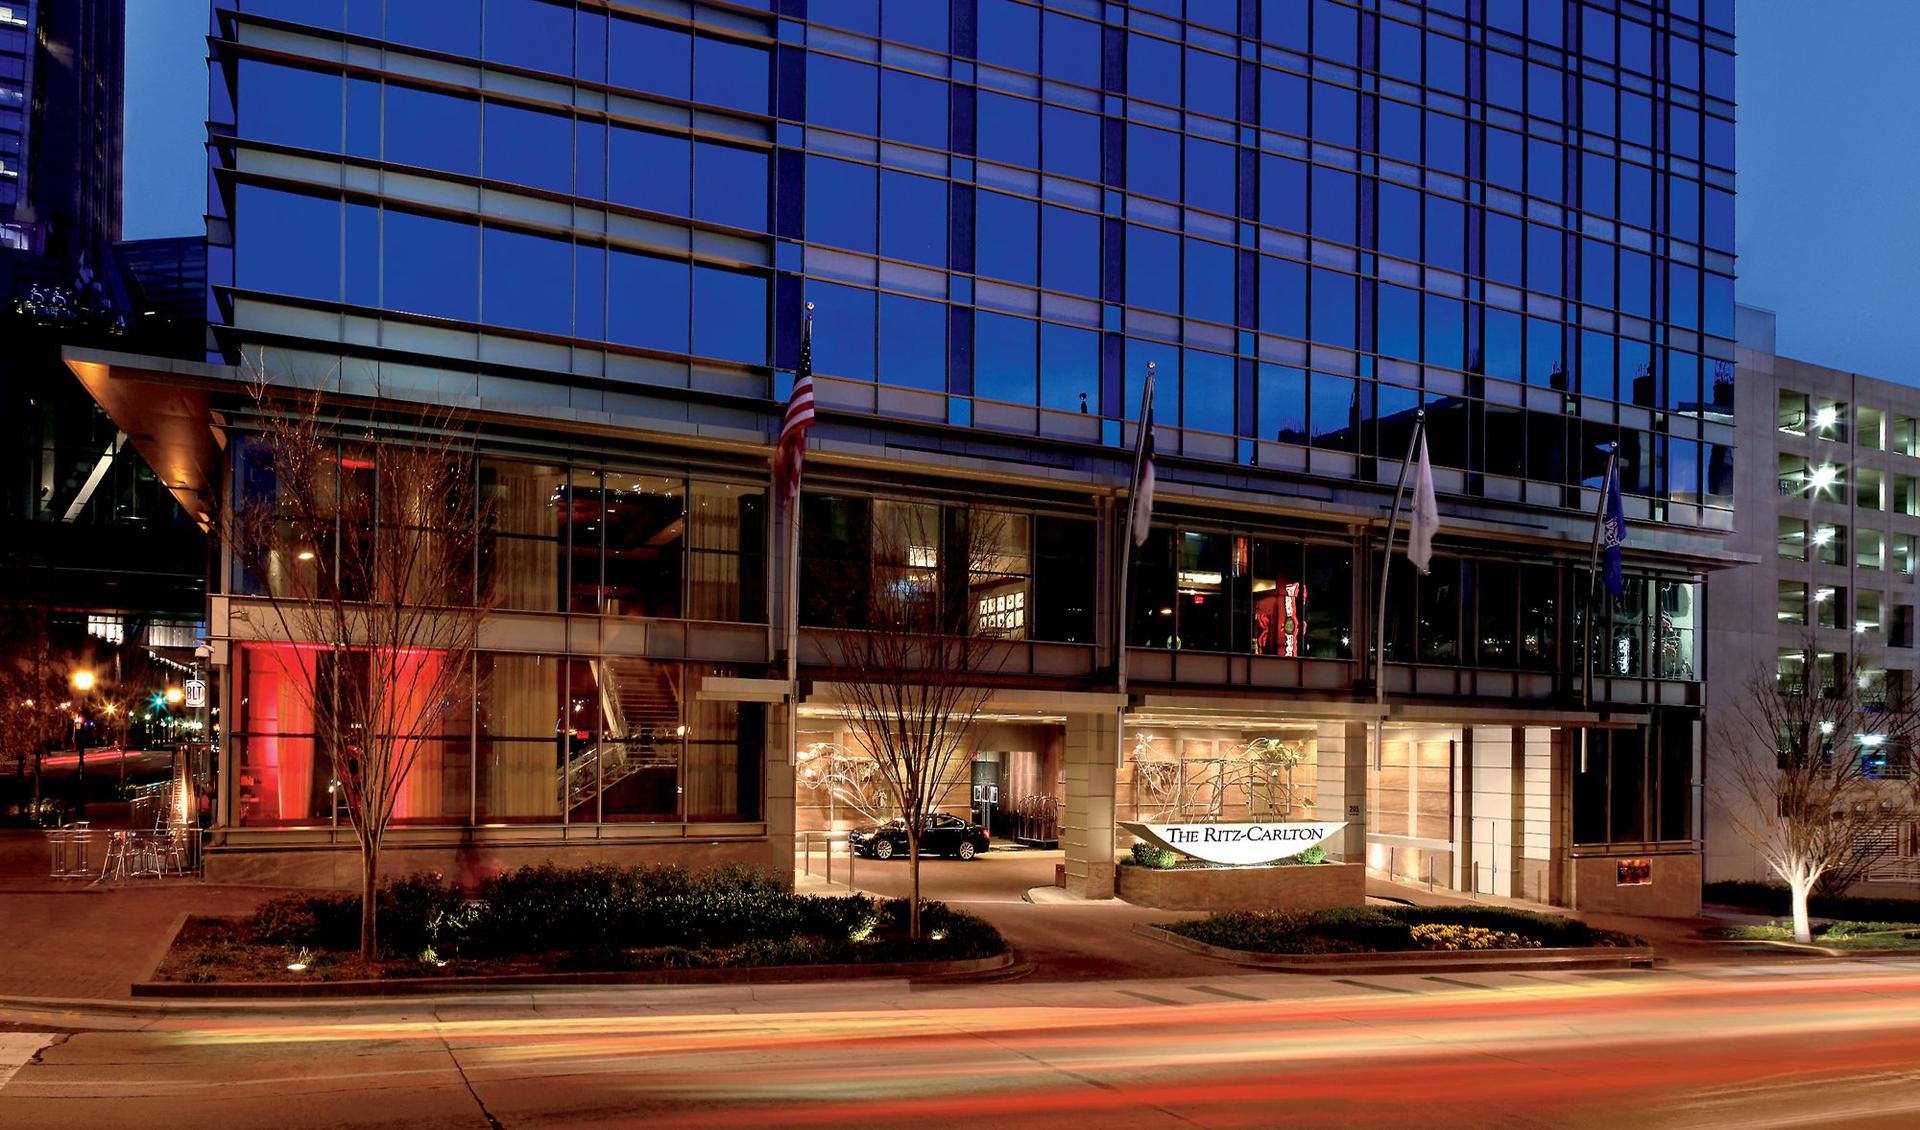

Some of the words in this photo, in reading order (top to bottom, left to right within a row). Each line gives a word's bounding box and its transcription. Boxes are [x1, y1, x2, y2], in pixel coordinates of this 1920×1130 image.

[186, 686, 202, 700] BLT
[1166, 827, 1199, 843] THE
[1203, 826, 1324, 842] RITZ-CARLTON
